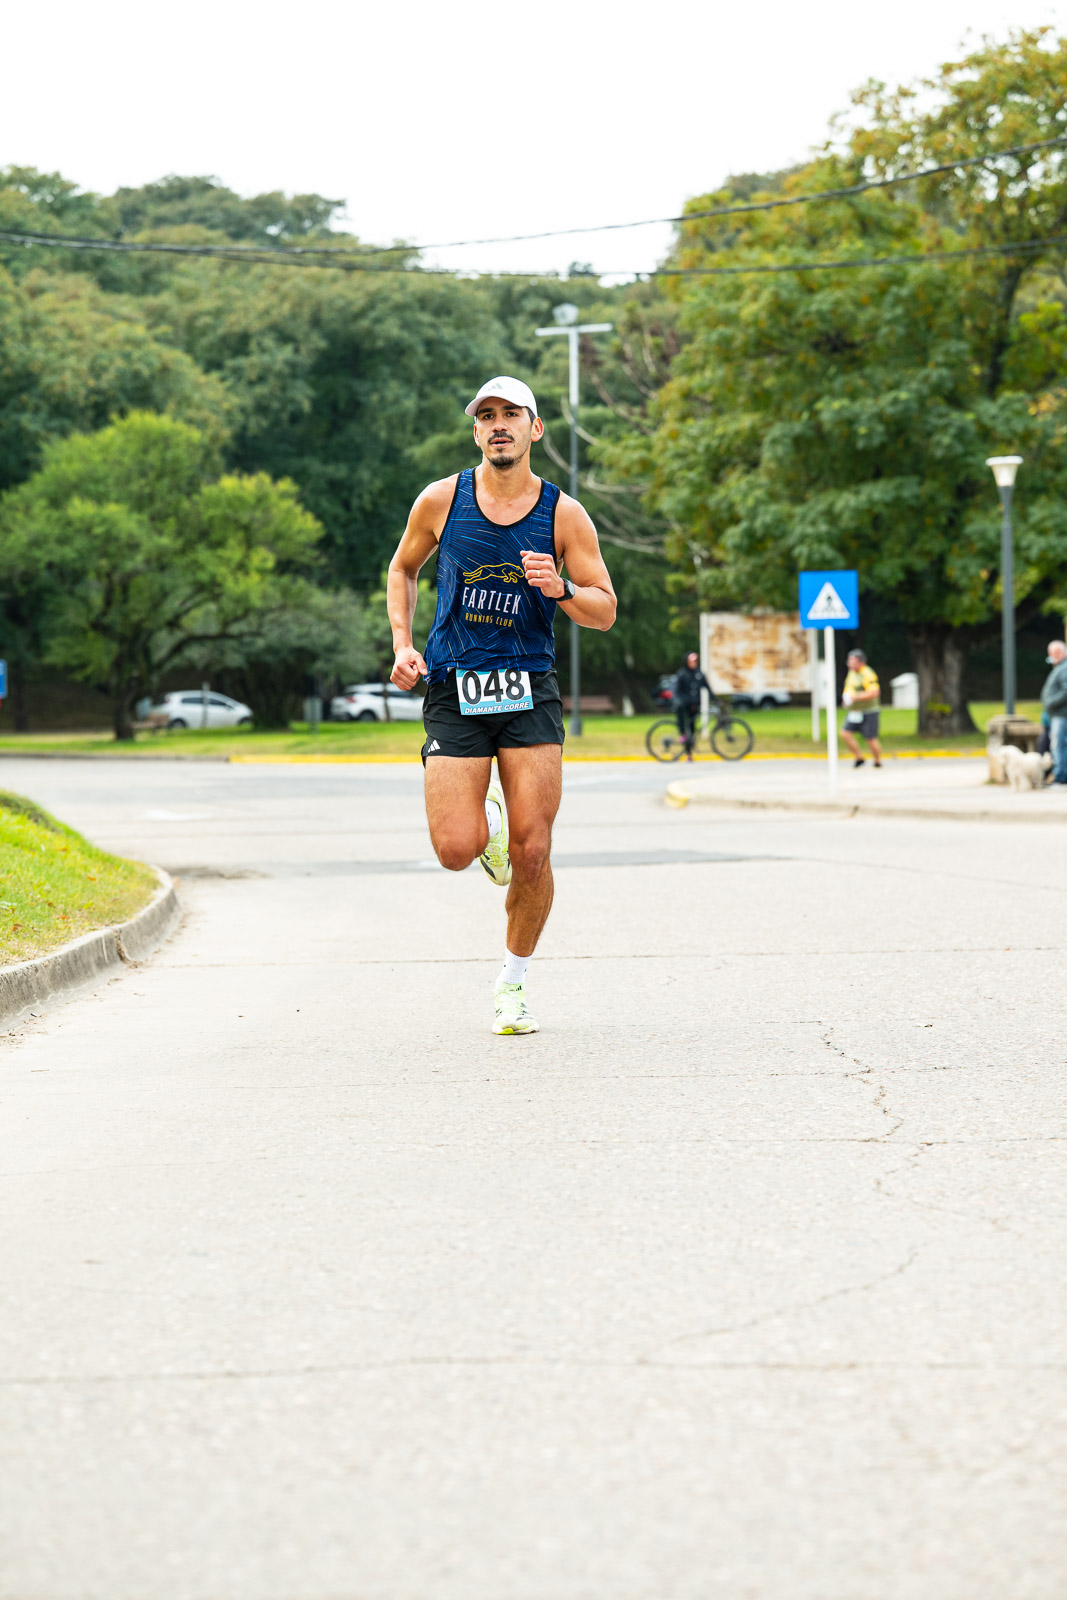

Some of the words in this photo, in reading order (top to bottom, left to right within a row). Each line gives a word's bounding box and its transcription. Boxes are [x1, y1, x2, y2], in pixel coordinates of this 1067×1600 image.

[462, 587, 521, 614] FARTLEK
[465, 612, 493, 624] RUNNING
[496, 616, 513, 627] CLUB
[462, 669, 525, 705] 048
[464, 705, 502, 714] DIAMANTE
[504, 701, 529, 711] CORRE
